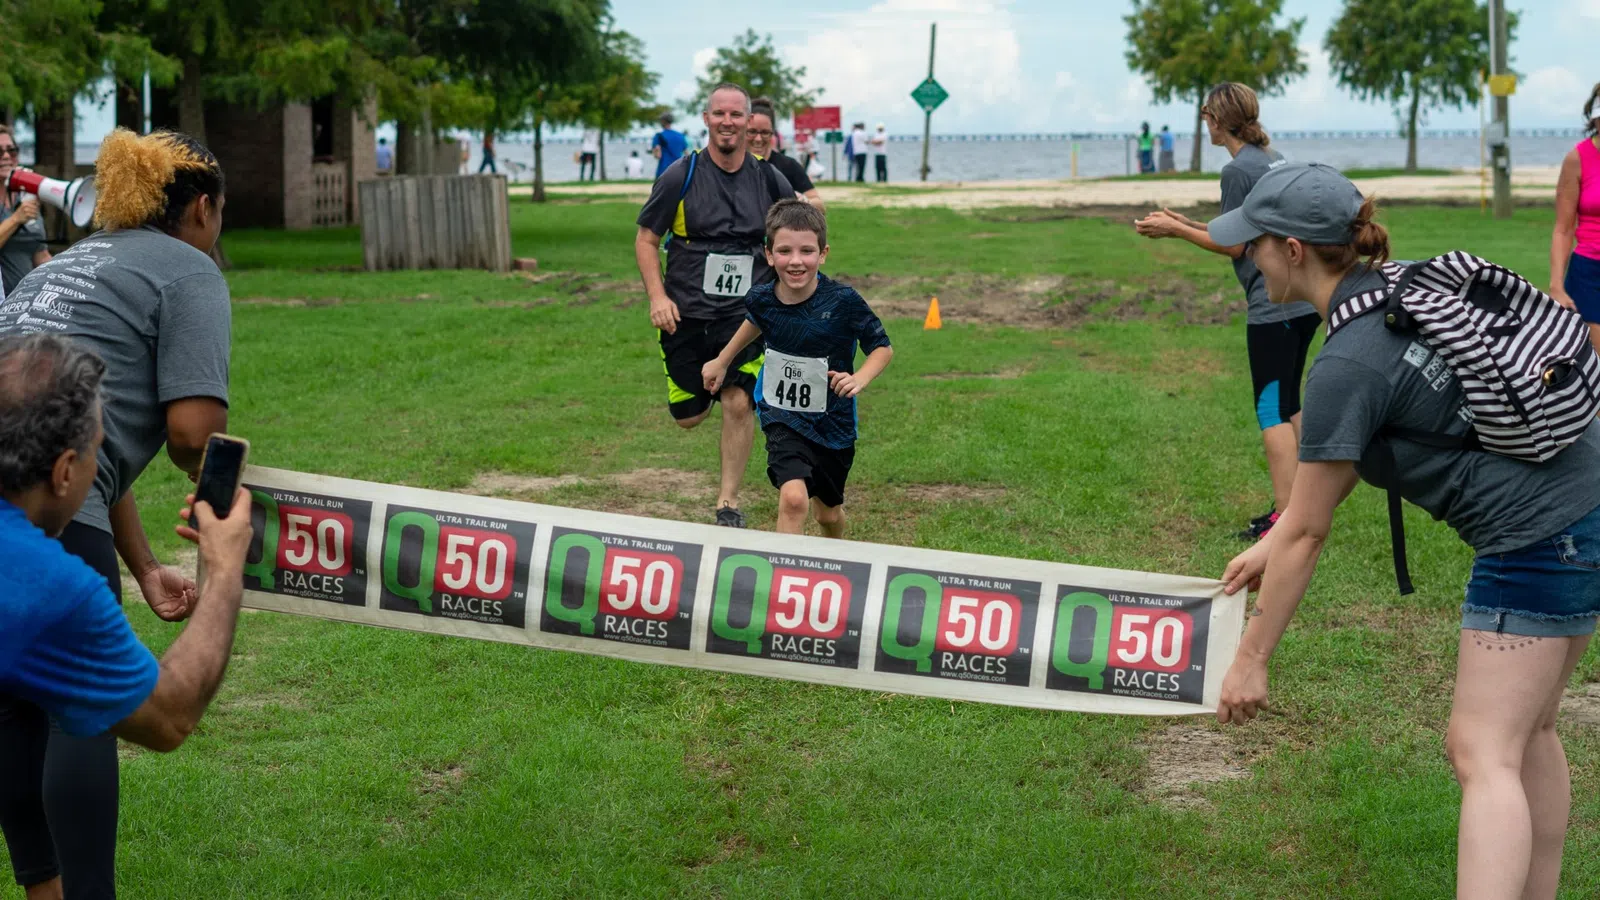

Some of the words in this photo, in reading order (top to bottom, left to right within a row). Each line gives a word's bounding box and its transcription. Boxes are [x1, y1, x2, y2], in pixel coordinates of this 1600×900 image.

[715, 274, 742, 294] 447
[50, 300, 74, 314] MELE
[776, 380, 811, 408] 448
[273, 493, 300, 503] ULTRA
[302, 497, 325, 507] TRAIL
[326, 500, 344, 508] RUN
[436, 514, 462, 524] ULTRA
[465, 518, 488, 527] TRAIL
[490, 521, 507, 530] RUN
[601, 536, 628, 546] ULTRA
[632, 540, 654, 550] TRAIL
[656, 543, 674, 552] RUN
[769, 556, 796, 566] ULTRA
[799, 559, 822, 569] TRAIL
[824, 562, 842, 570] RUN
[284, 570, 343, 594] RACES
[938, 576, 965, 586] ULTRA
[968, 578, 992, 588] TRAIL
[993, 581, 1012, 590] RUN
[441, 594, 502, 616] RACES
[1109, 594, 1136, 604] ULTRA
[1139, 597, 1162, 606] TRAIL
[604, 615, 668, 638] RACES
[604, 633, 667, 646] www.q50races.com
[772, 634, 836, 657] RACES
[770, 652, 835, 664] www.q50races.com
[941, 652, 1006, 675] RACES
[940, 670, 1006, 683] www.q50races.com
[1114, 668, 1180, 692] RACES
[1112, 687, 1179, 700] www.q50races.com
